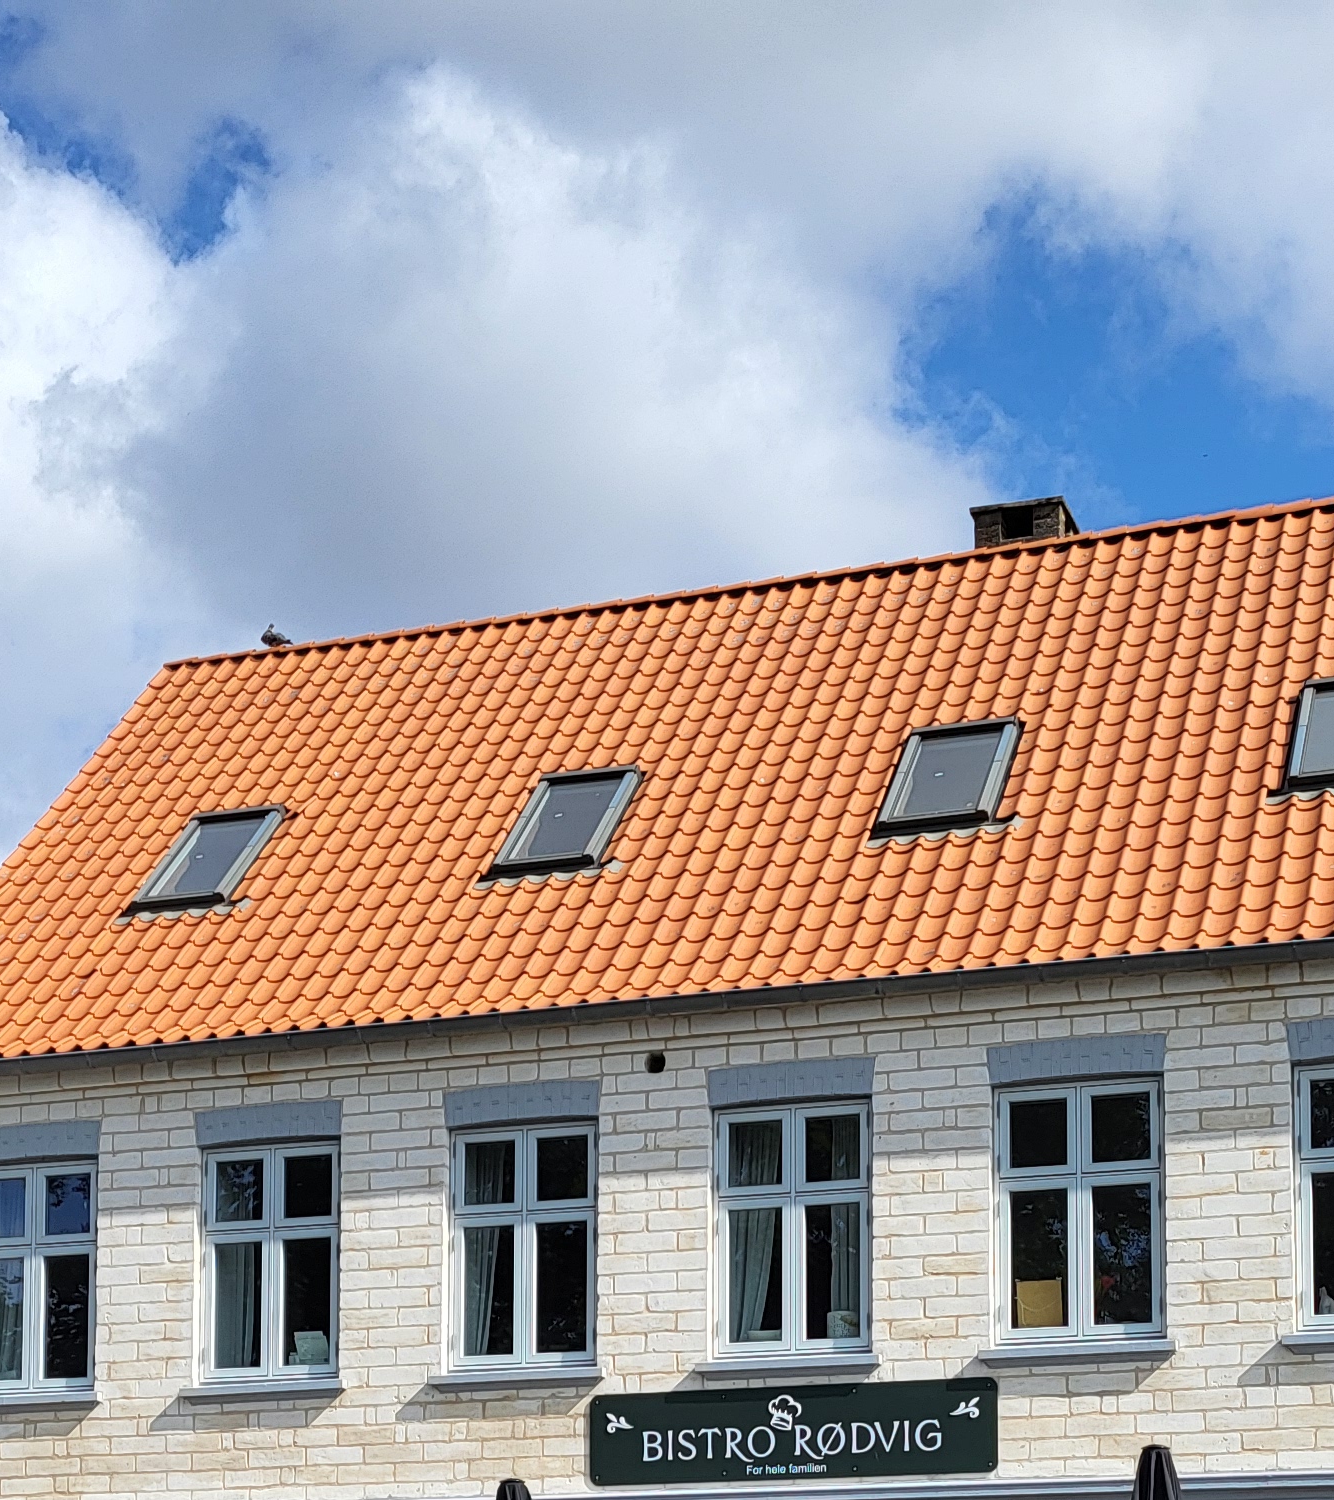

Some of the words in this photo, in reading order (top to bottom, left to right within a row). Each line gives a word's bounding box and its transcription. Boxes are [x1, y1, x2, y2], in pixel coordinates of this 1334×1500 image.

[642, 1425, 776, 1463] BISTRO
[794, 1418, 943, 1460] RØDVIG
[746, 1465, 763, 1475] For
[788, 1463, 827, 1474] familien
